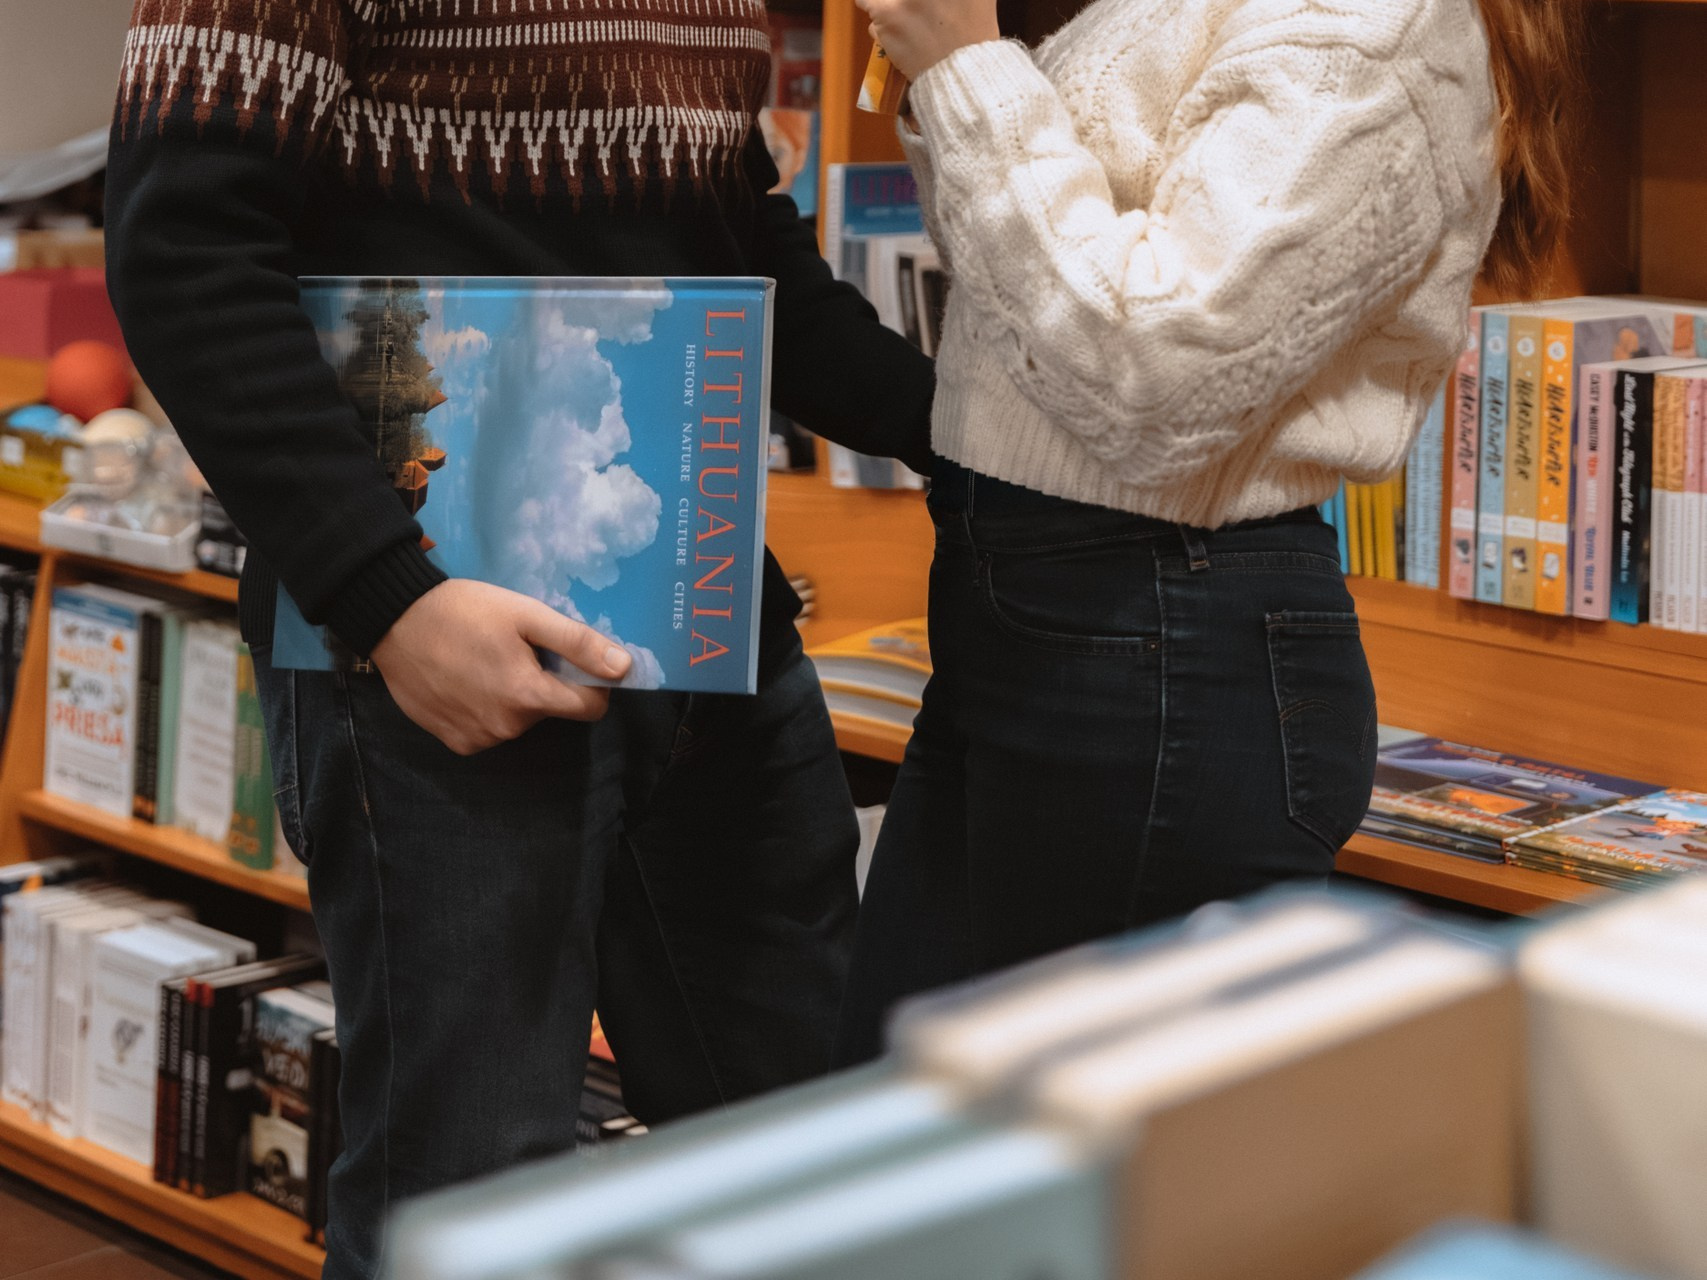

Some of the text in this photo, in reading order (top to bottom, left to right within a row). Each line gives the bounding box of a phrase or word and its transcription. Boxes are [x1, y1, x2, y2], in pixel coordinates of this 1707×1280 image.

[1590, 373, 1602, 403] CASEY
[1623, 374, 1637, 402] Last
[1620, 402, 1637, 432] Night
[673, 344, 697, 630] HISTORY NATURE CULTURE CITIES
[689, 307, 746, 668] LITHUANIA
[1618, 448, 1635, 499] Telegraph
[1620, 500, 1635, 524] Club
